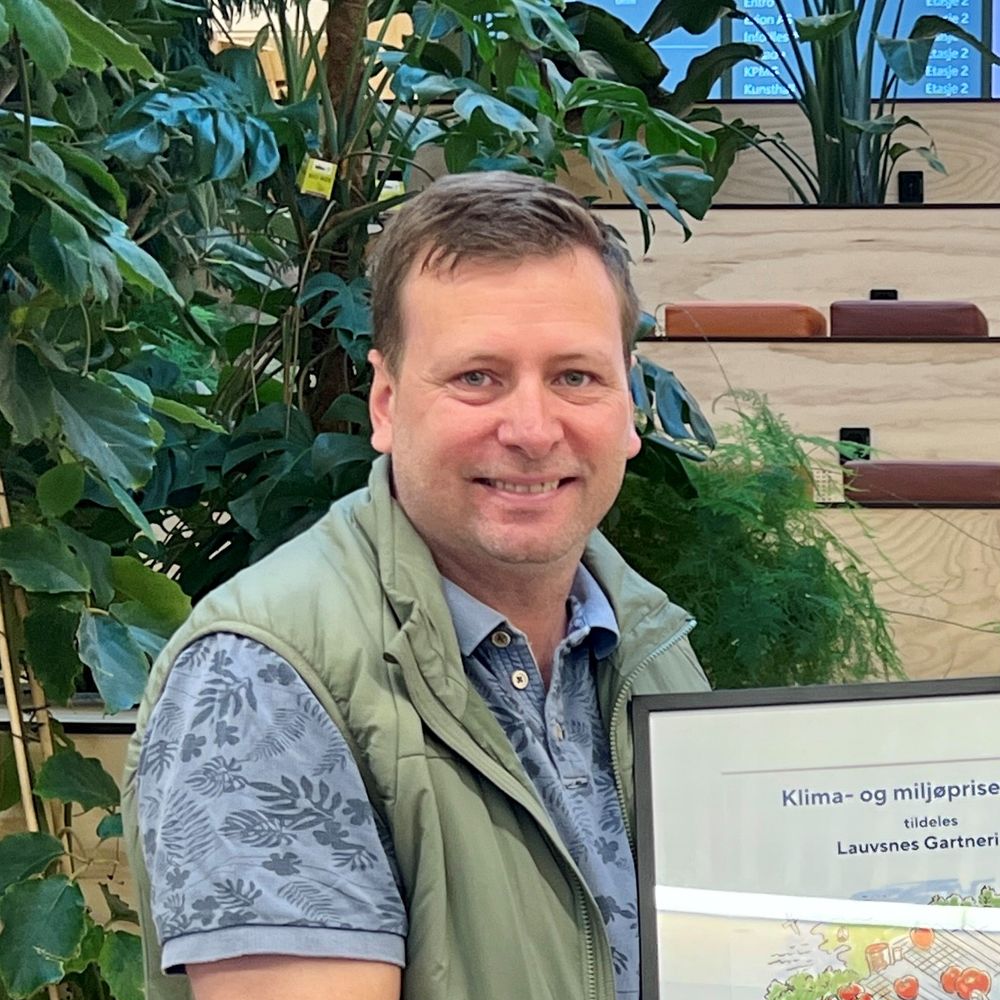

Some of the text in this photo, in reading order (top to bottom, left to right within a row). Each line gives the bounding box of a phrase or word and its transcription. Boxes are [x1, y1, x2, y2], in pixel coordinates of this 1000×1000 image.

[961, 48, 969, 59] 2
[926, 65, 969, 79] Etasje 2
[926, 83, 969, 97] Etasje 2
[782, 789, 853, 806] Klima-
[860, 788, 887, 806] og
[904, 815, 958, 829] tildeles
[837, 840, 919, 855] Lauvsnes
[924, 832, 999, 850] Gartneri
